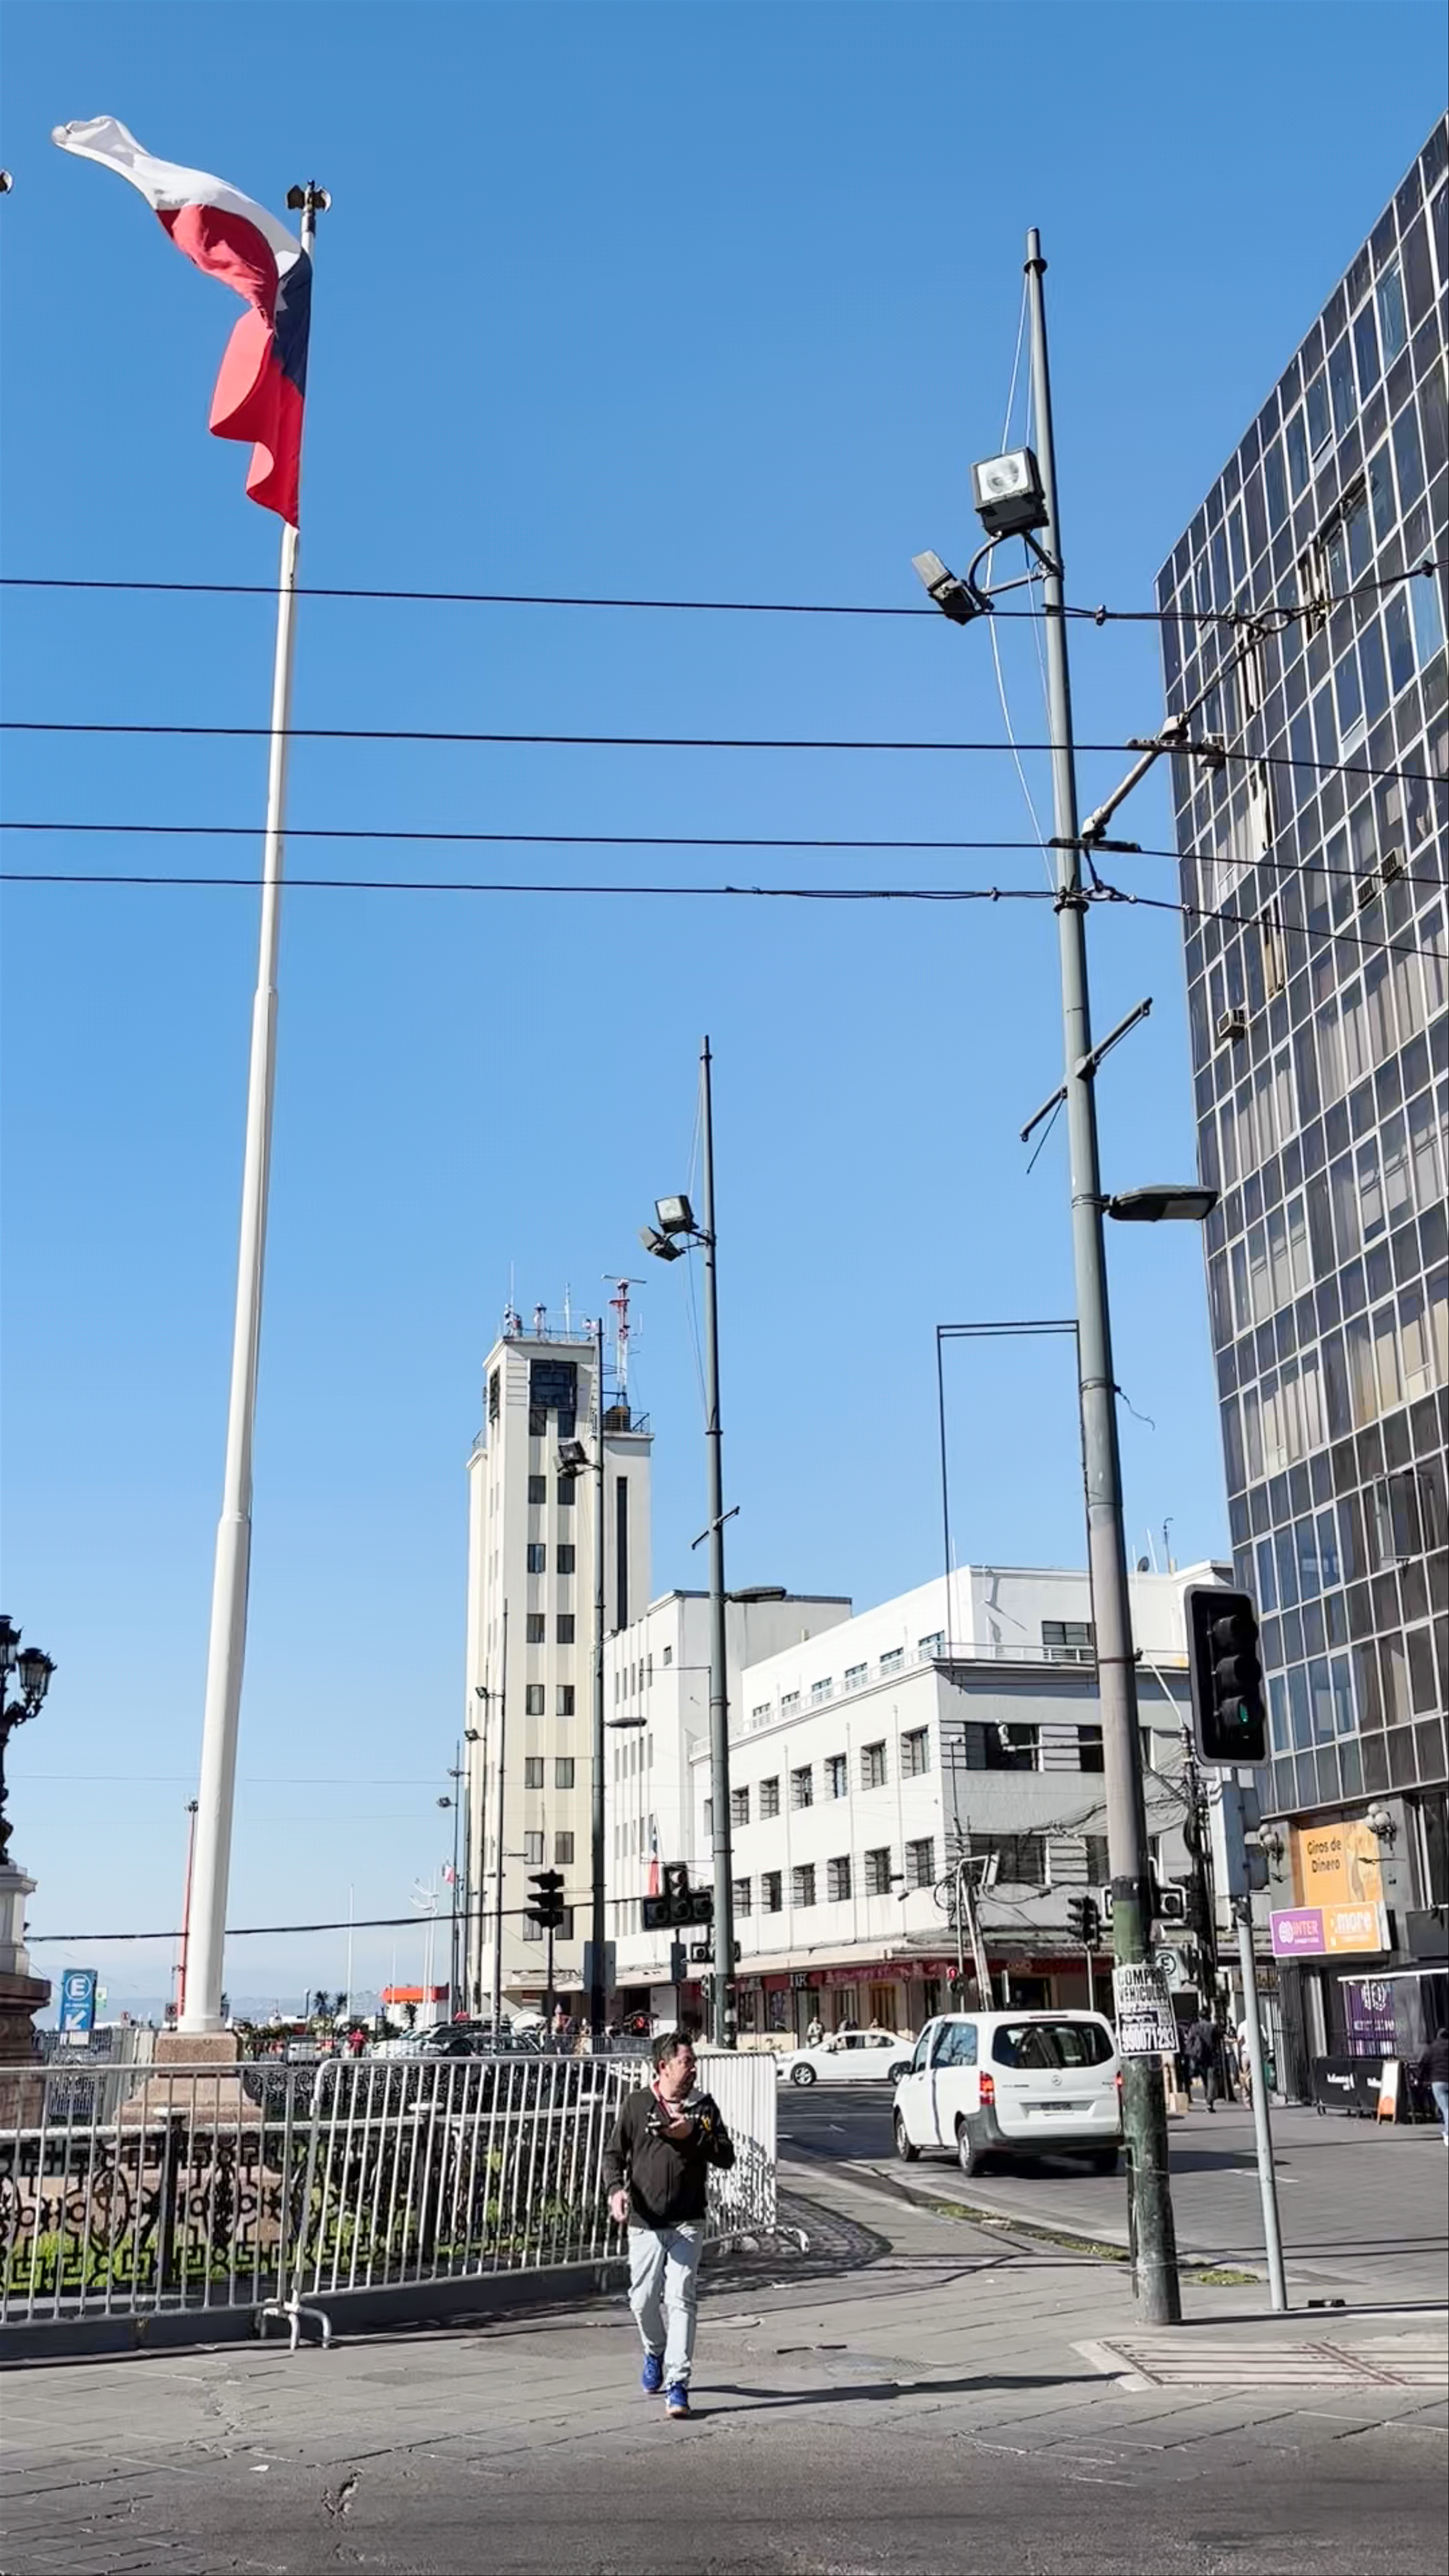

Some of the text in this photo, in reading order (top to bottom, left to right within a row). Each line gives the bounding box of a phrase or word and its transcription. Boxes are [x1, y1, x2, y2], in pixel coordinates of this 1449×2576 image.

[1307, 1837, 1341, 1855] Giros de
[1312, 1857, 1340, 1873] Dinero
[71, 1978, 85, 1996] E
